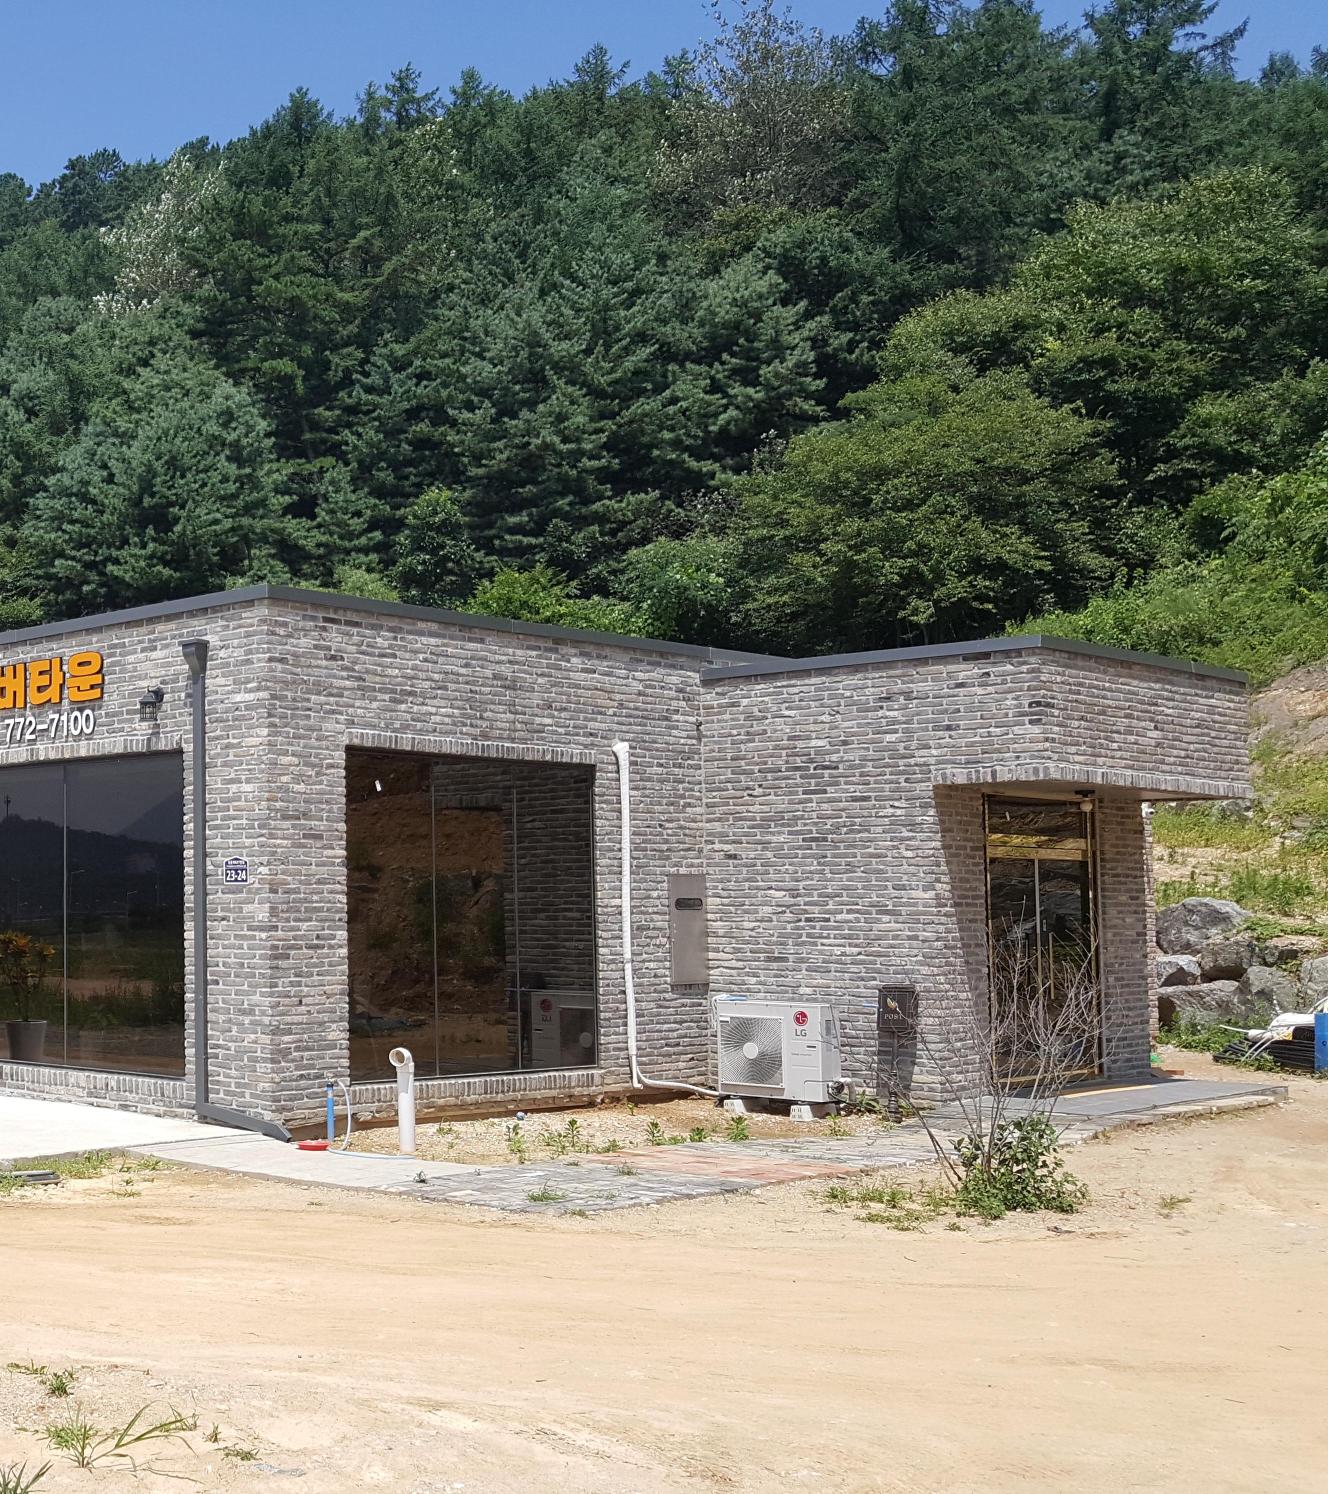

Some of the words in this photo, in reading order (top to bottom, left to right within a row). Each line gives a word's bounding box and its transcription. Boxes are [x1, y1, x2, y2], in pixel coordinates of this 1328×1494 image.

[5, 709, 95, 747] 772-7100
[226, 870, 246, 880] 23-24
[795, 1029, 807, 1037] LG
